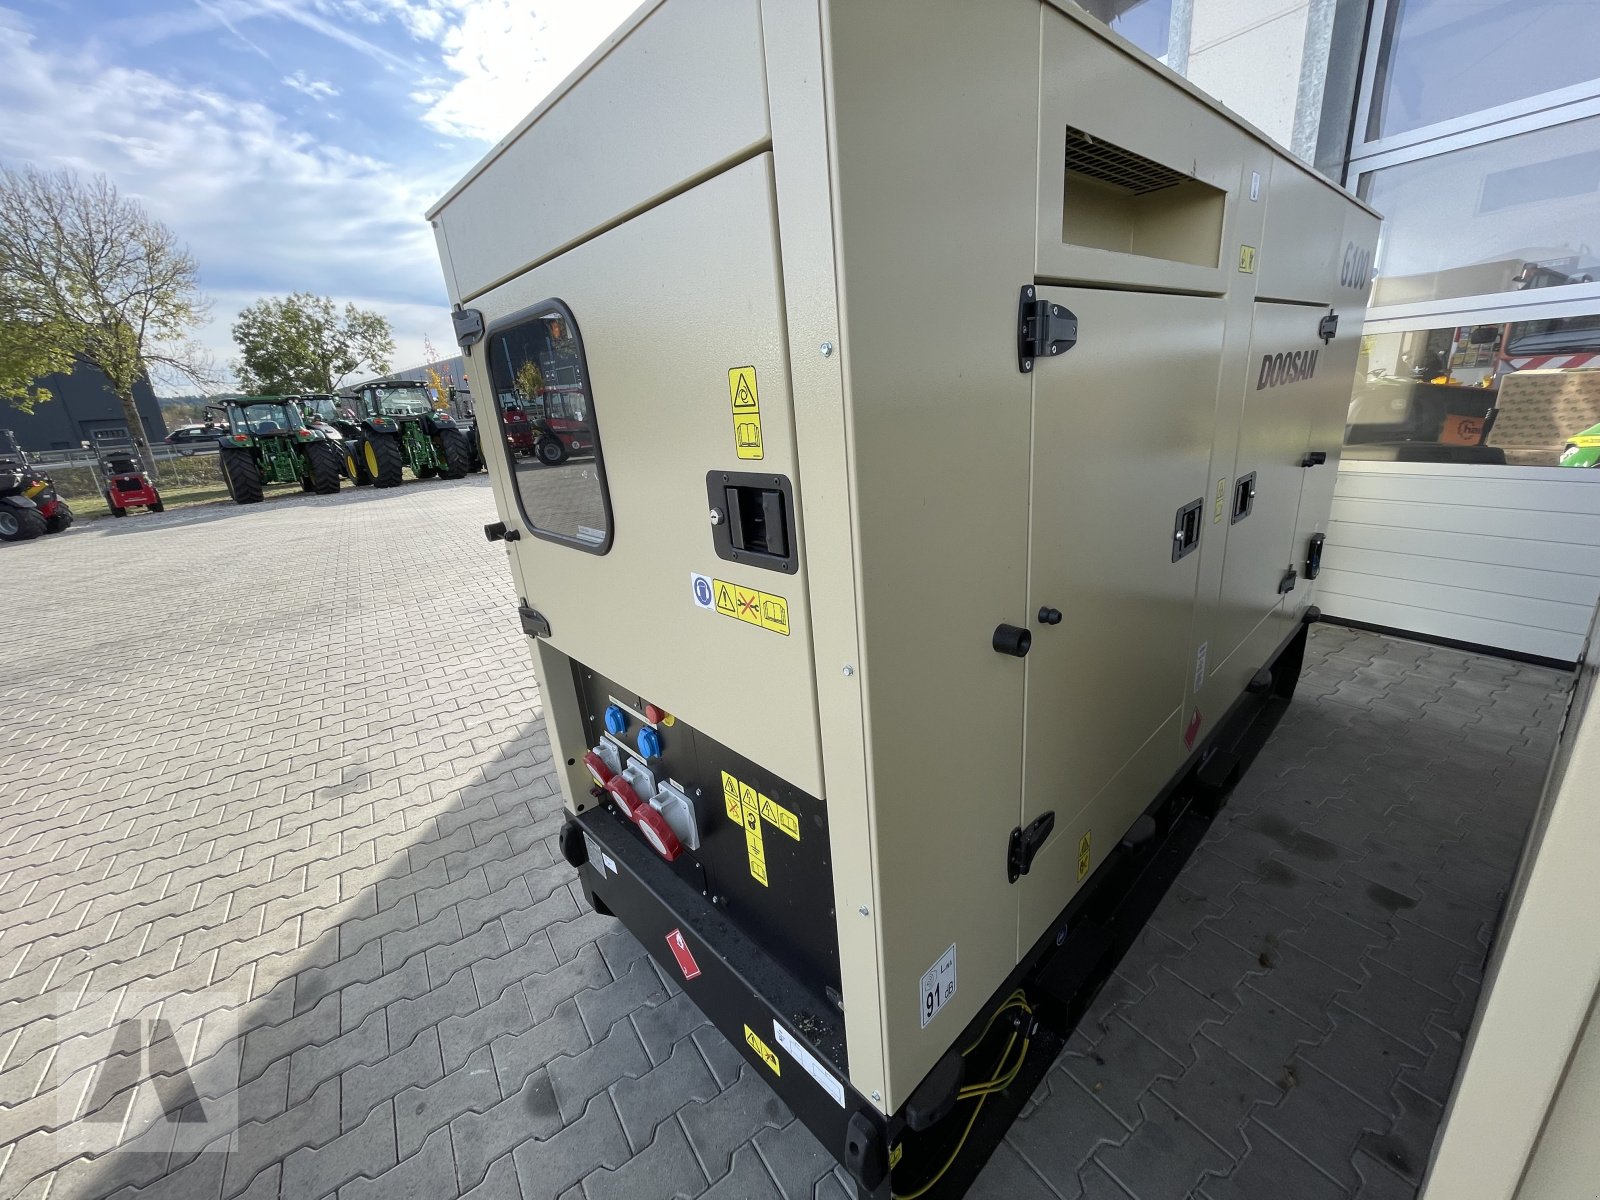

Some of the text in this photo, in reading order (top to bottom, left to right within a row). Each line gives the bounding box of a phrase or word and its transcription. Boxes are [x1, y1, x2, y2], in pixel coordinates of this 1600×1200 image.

[1341, 241, 1371, 291] G100
[1257, 350, 1319, 391] DOOSAN
[926, 980, 954, 1018] 91 dB
